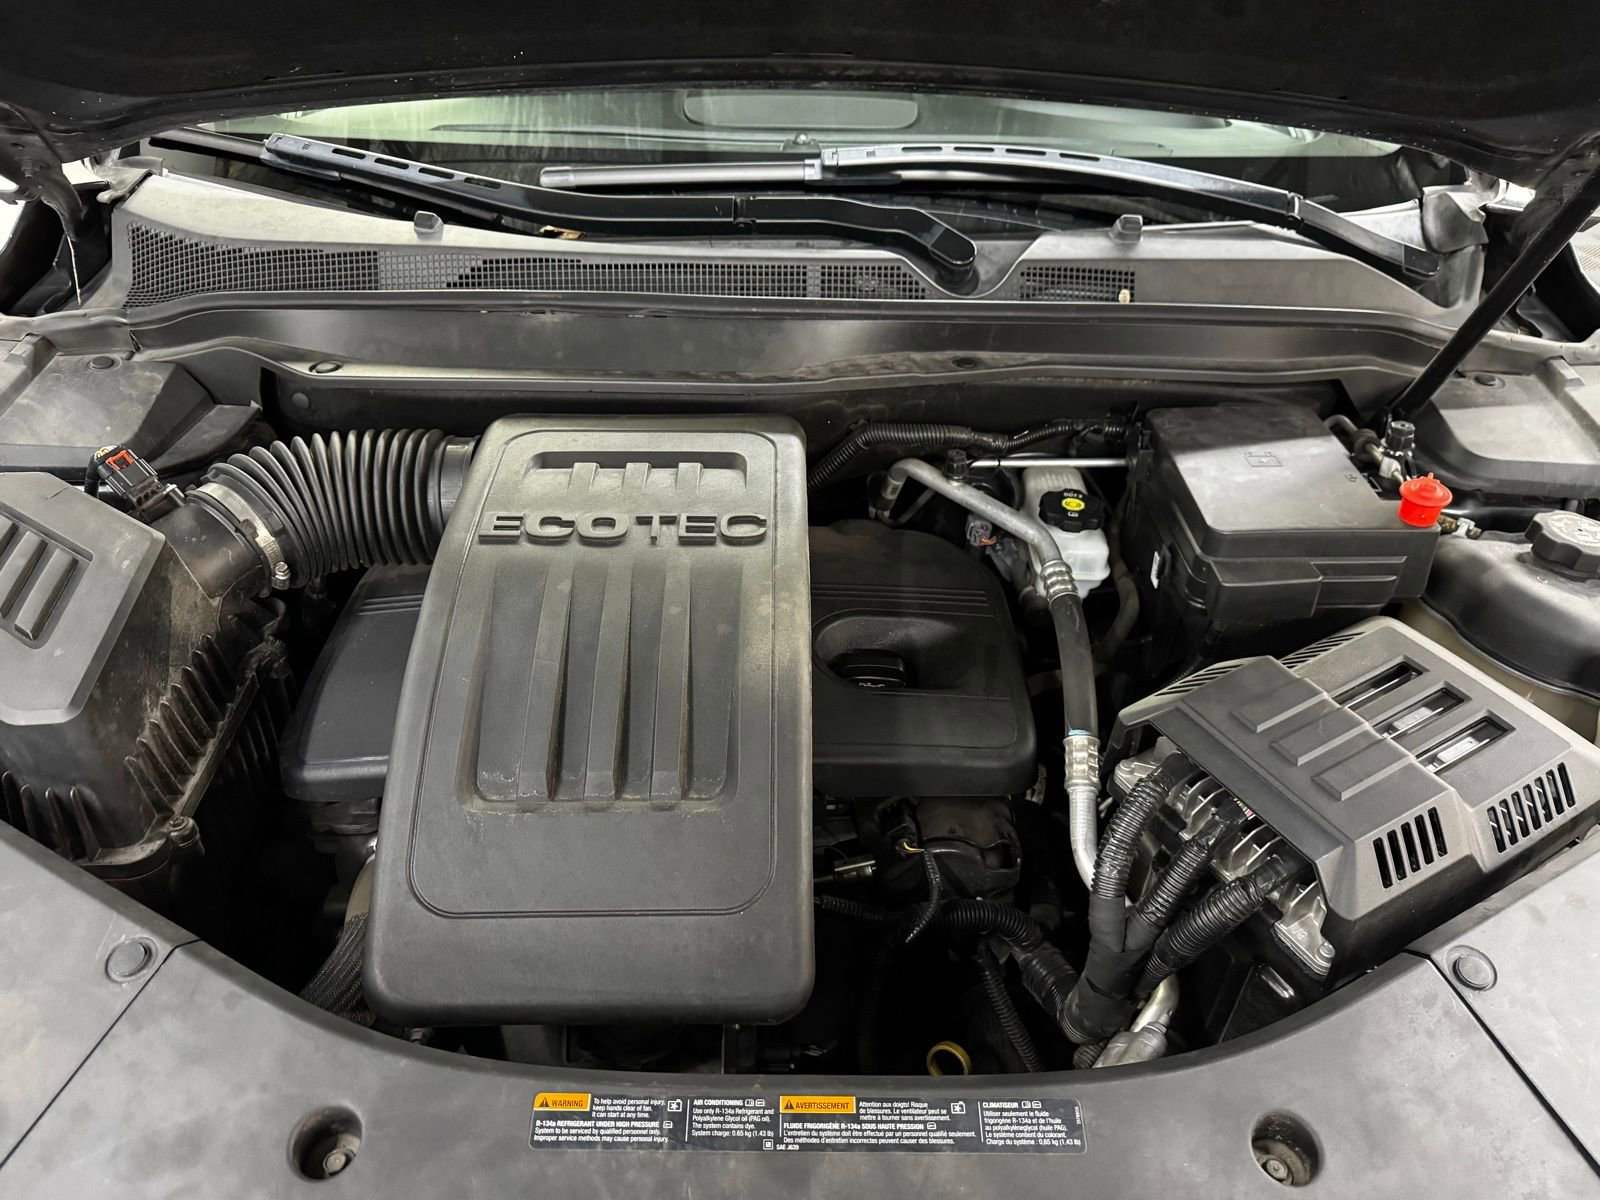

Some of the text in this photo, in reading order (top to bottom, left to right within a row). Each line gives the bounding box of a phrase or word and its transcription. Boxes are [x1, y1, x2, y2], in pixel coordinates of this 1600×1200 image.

[478, 511, 768, 547] ECOTEC
[551, 1099, 584, 1107] WARNING
[796, 1102, 850, 1110] AVERTISSEMENT
[911, 1101, 929, 1109] Risque
[736, 1108, 764, 1116] Refrigerant
[745, 1123, 756, 1131] dye.
[1039, 1124, 1054, 1132] (huile
[535, 1127, 555, 1135] System
[592, 1128, 600, 1136] by
[600, 1128, 622, 1136] qualified
[649, 1129, 661, 1137] only.
[745, 1130, 752, 1138] kg
[767, 1130, 775, 1138] lb)
[948, 1130, 977, 1138] seulement.
[654, 1136, 669, 1144] injury.
[878, 1137, 900, 1145] peuvent
[929, 1137, 955, 1145] blessures.
[986, 1138, 1005, 1146] Charge
[1051, 1138, 1059, 1146] kg
[1073, 1138, 1081, 1147] lb)
